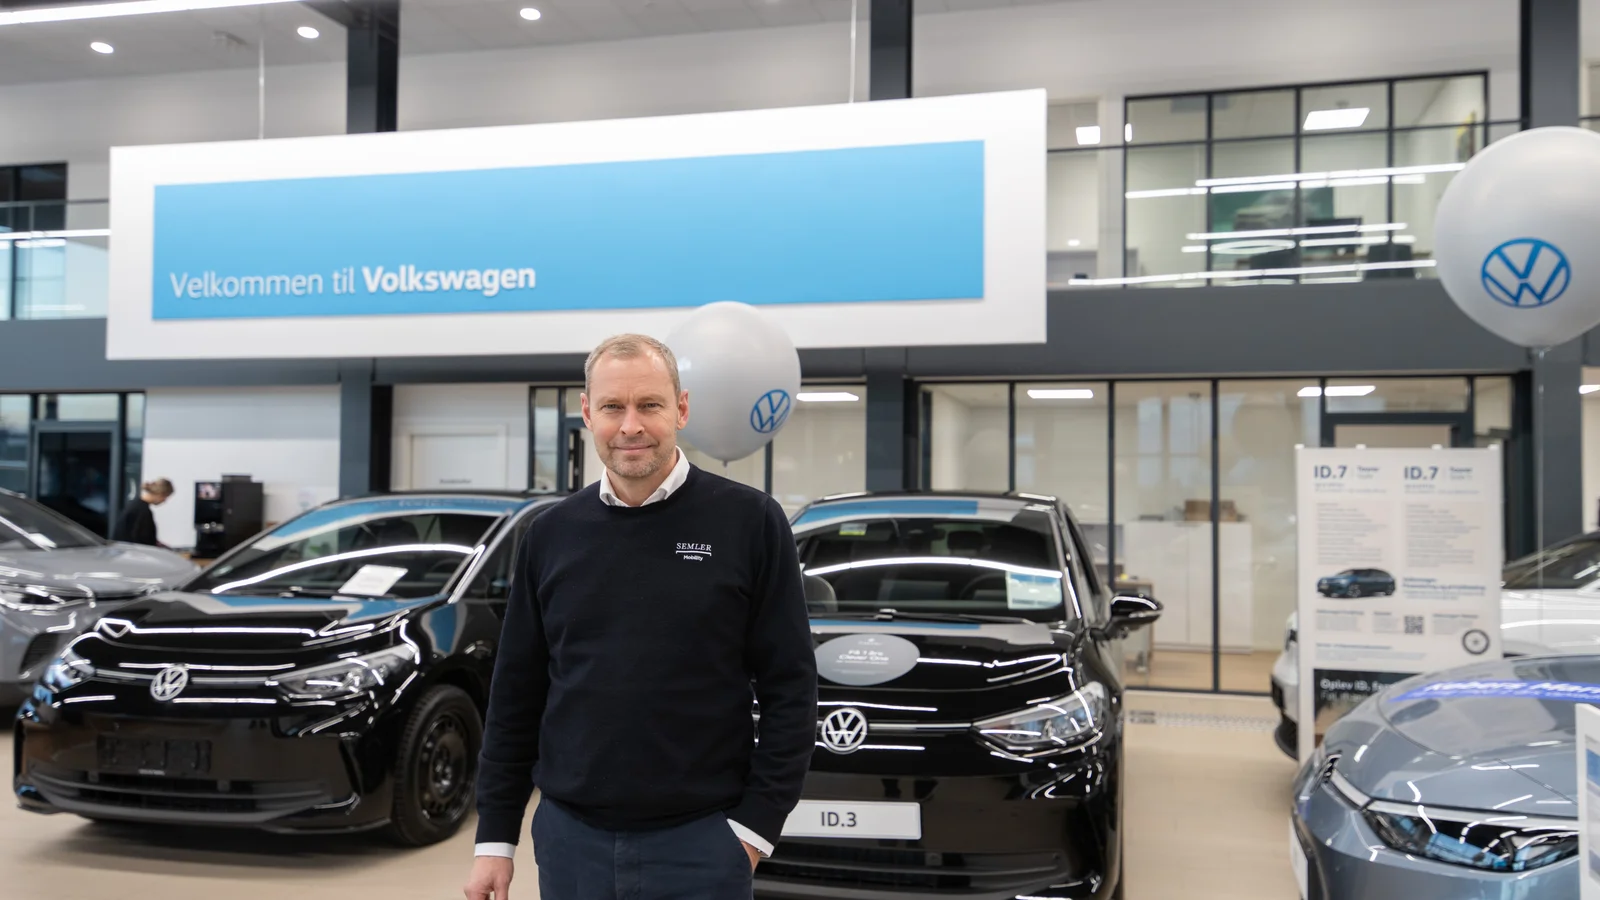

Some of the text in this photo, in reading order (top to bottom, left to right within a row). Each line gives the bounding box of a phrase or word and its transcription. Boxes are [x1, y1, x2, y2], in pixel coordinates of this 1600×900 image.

[169, 264, 536, 300] Velkommen til Volkswagen
[1314, 465, 1348, 479] ID.7
[1403, 466, 1439, 480] ID.7
[676, 543, 712, 551] SEMLER
[821, 811, 857, 828] ID.3
